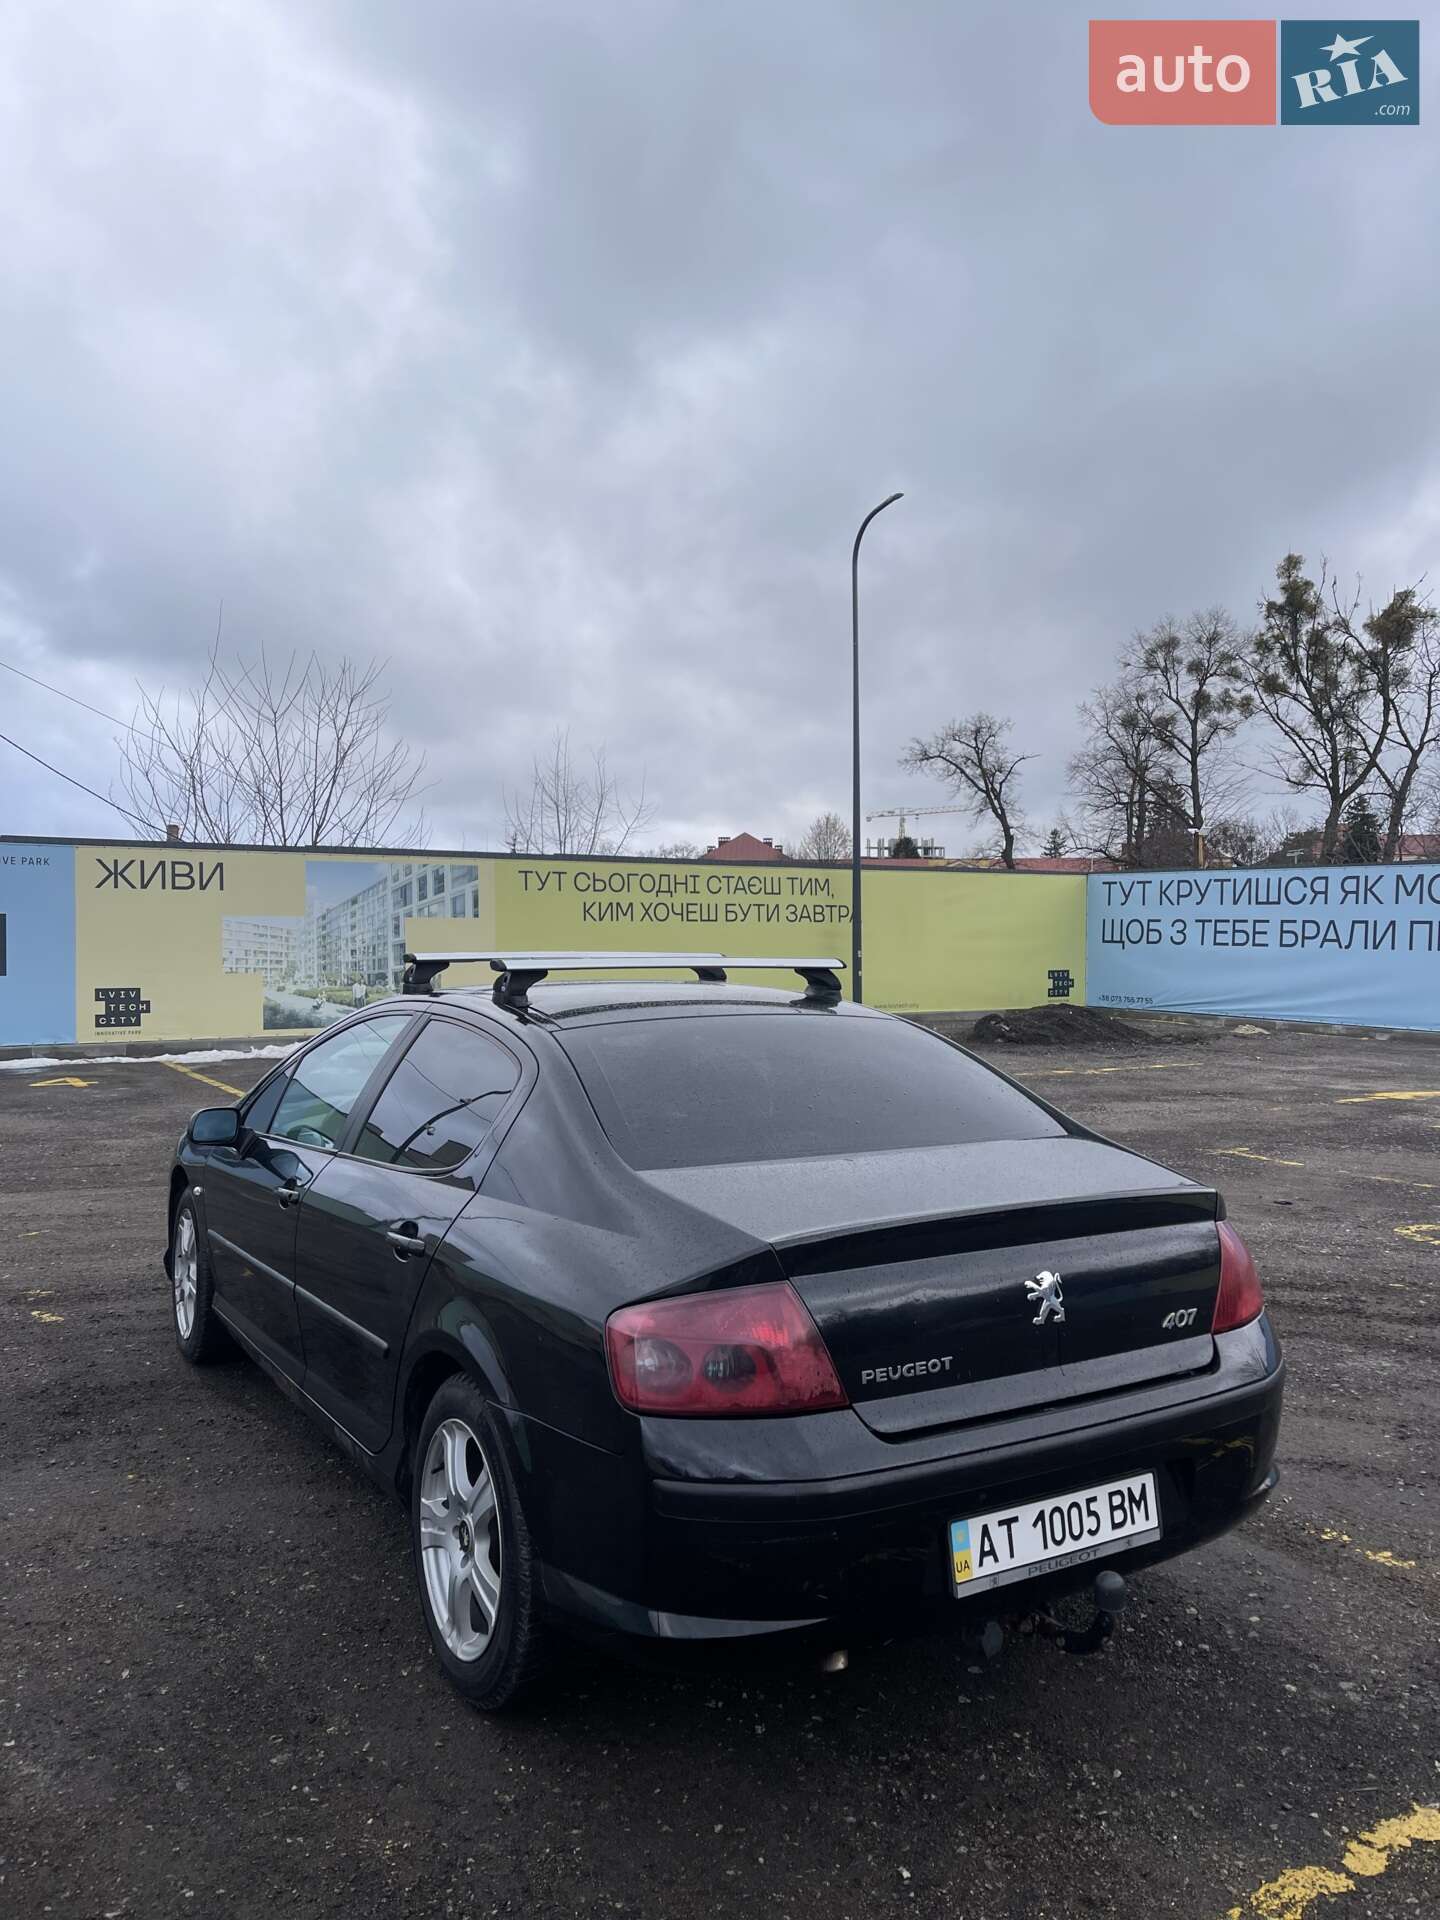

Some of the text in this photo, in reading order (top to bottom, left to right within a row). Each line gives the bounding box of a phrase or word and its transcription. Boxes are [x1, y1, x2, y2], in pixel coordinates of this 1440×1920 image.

[0, 856, 50, 866] VE PARK
[95, 858, 225, 891] ЖИВИ
[518, 870, 834, 899] ТУТ СЬОГОДНІ СТАЄШ ТИМ,
[1102, 880, 1152, 906] ТУТ
[1159, 876, 1329, 907] КРУТИШСЯ
[1339, 874, 1385, 905] ЯК
[583, 901, 855, 923] КИМ ХОЧЕШ БУТИ ЗАВТР
[1102, 918, 1162, 950] ЩОБ
[1195, 919, 1268, 947] ТЕБЕ
[1279, 920, 1396, 951] БРАЛИ
[1408, 920, 1440, 951] П
[99, 991, 136, 999] LVIV
[109, 1003, 146, 1011] TECH
[99, 1016, 136, 1025] CITY
[1162, 1307, 1199, 1329] 407
[861, 1356, 954, 1385] PEUGEOT
[978, 1483, 1150, 1568] AT 1005 BM
[956, 1559, 971, 1573] UA
[1027, 1550, 1099, 1577] PEUGEOT
